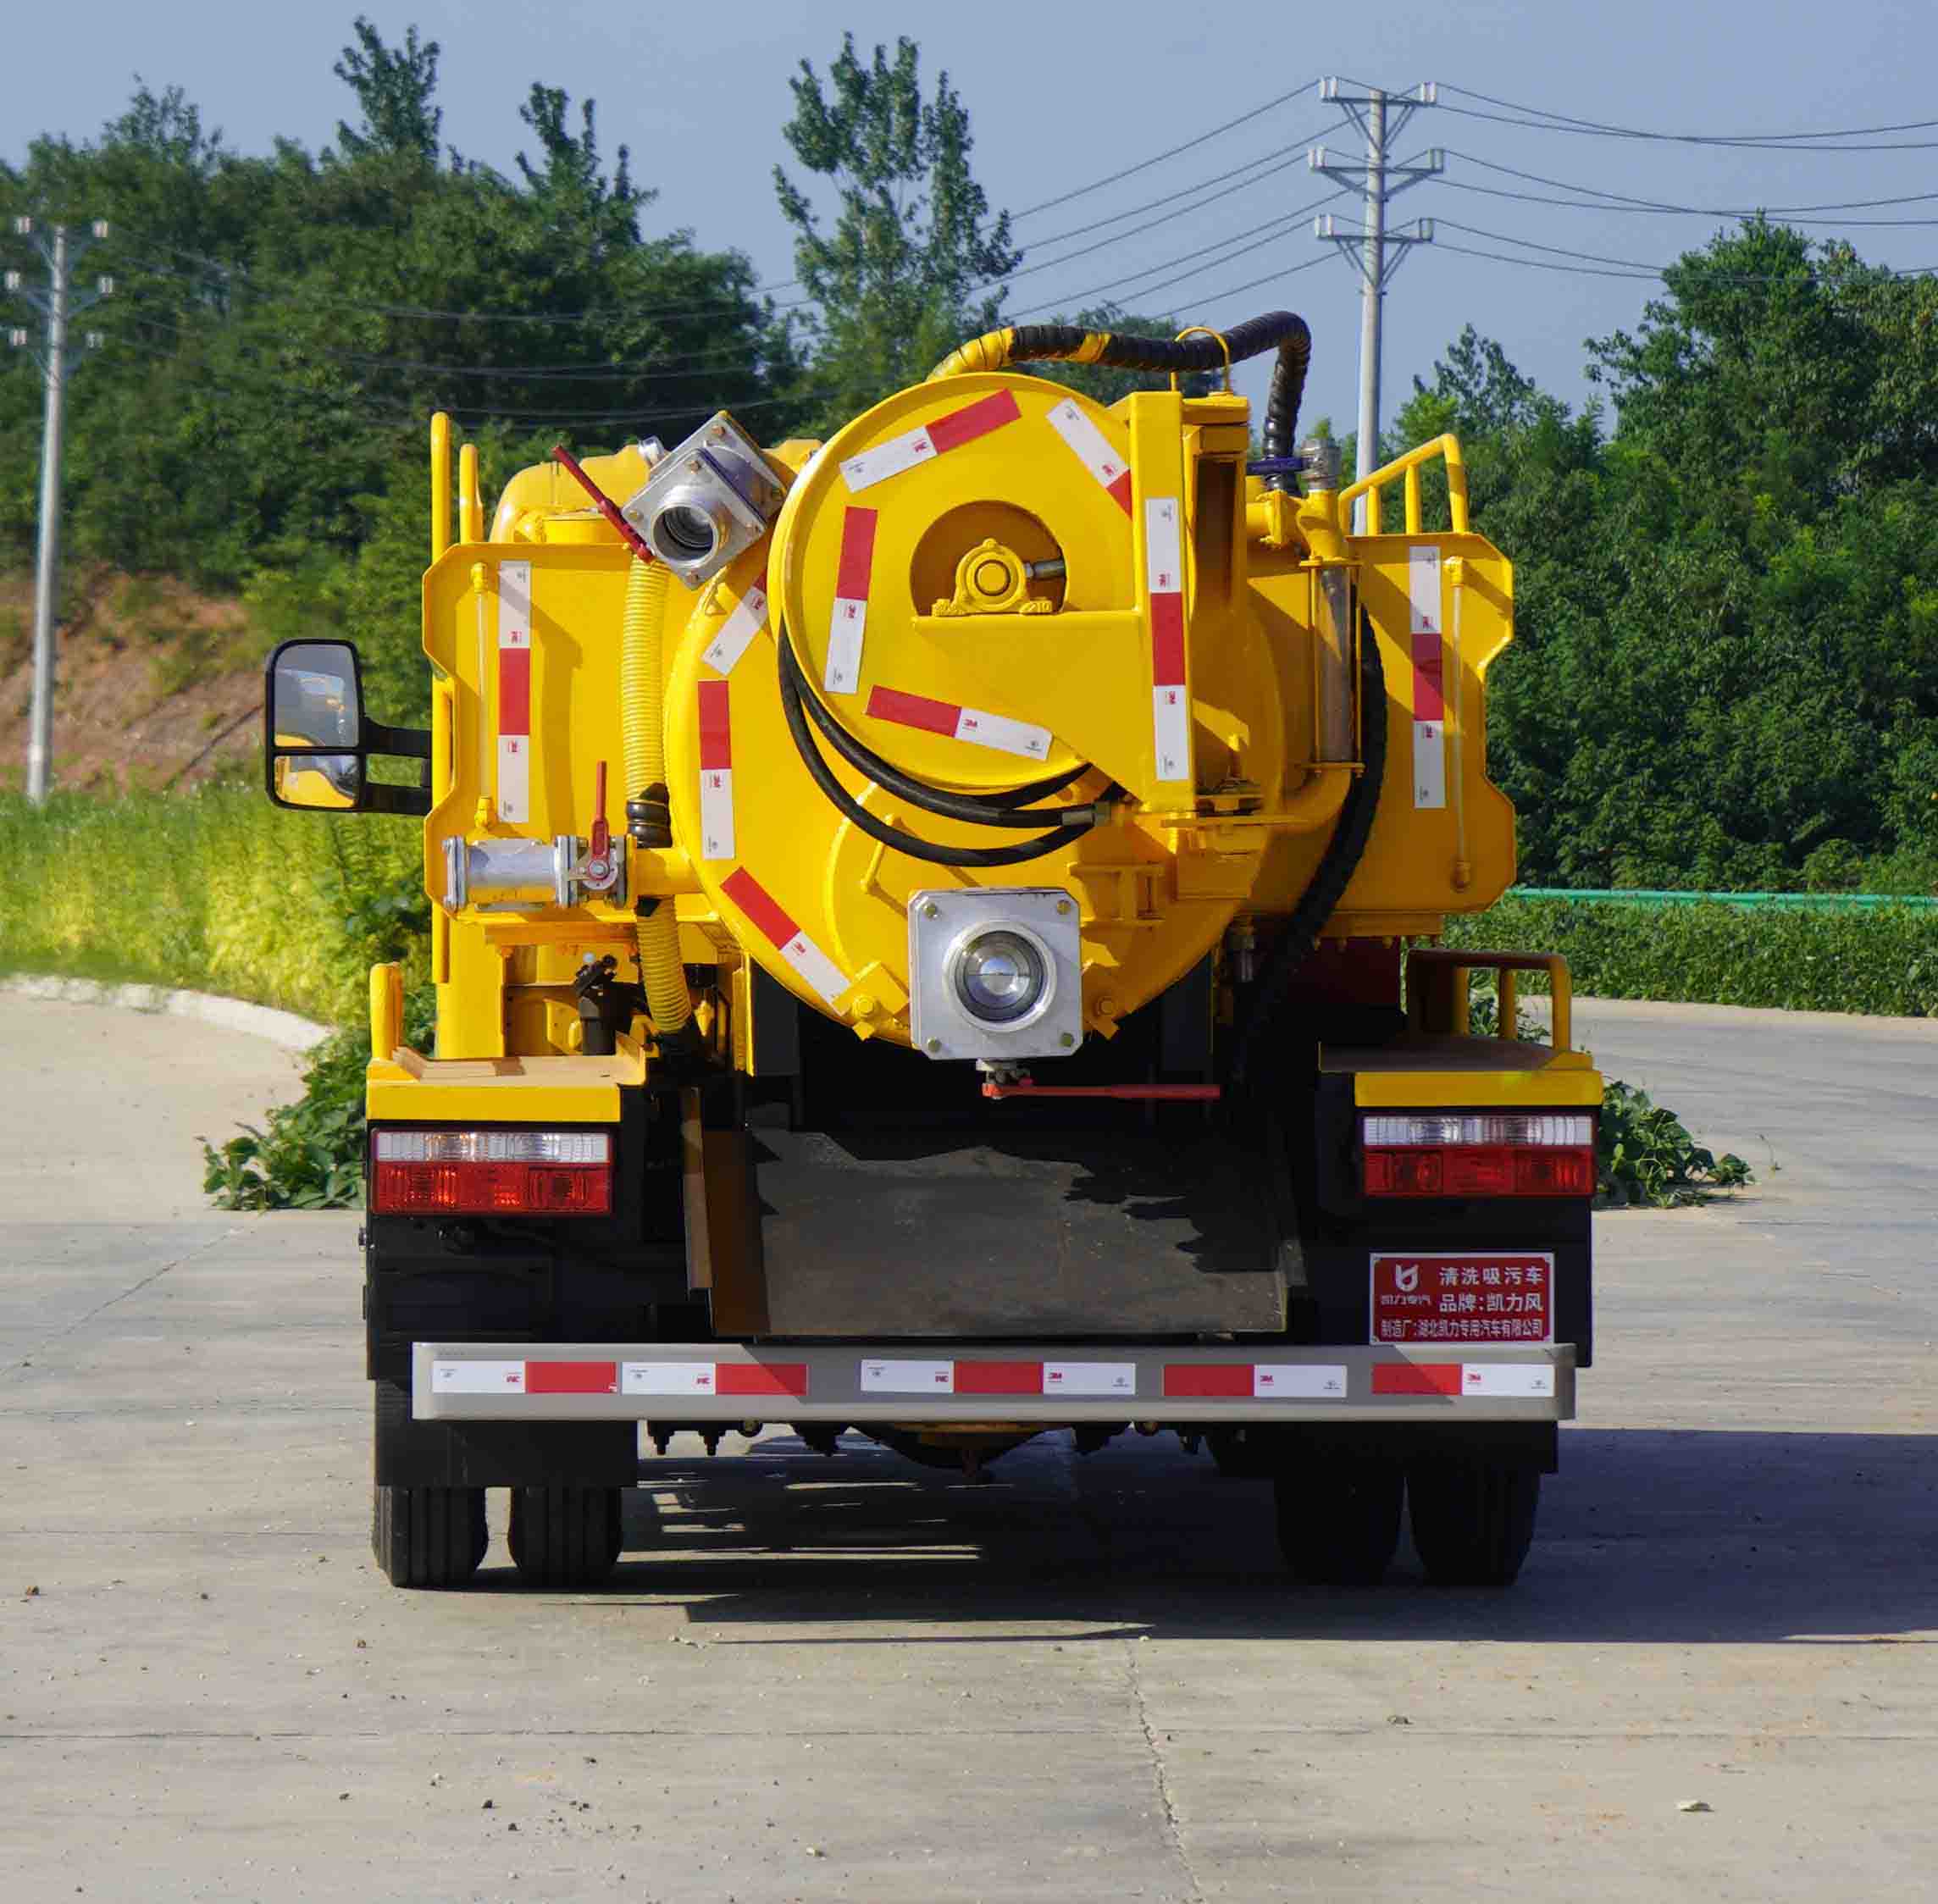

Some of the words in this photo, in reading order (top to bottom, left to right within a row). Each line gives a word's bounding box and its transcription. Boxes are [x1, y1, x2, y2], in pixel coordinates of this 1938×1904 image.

[1439, 1266, 1543, 1285] 清洗吸污车
